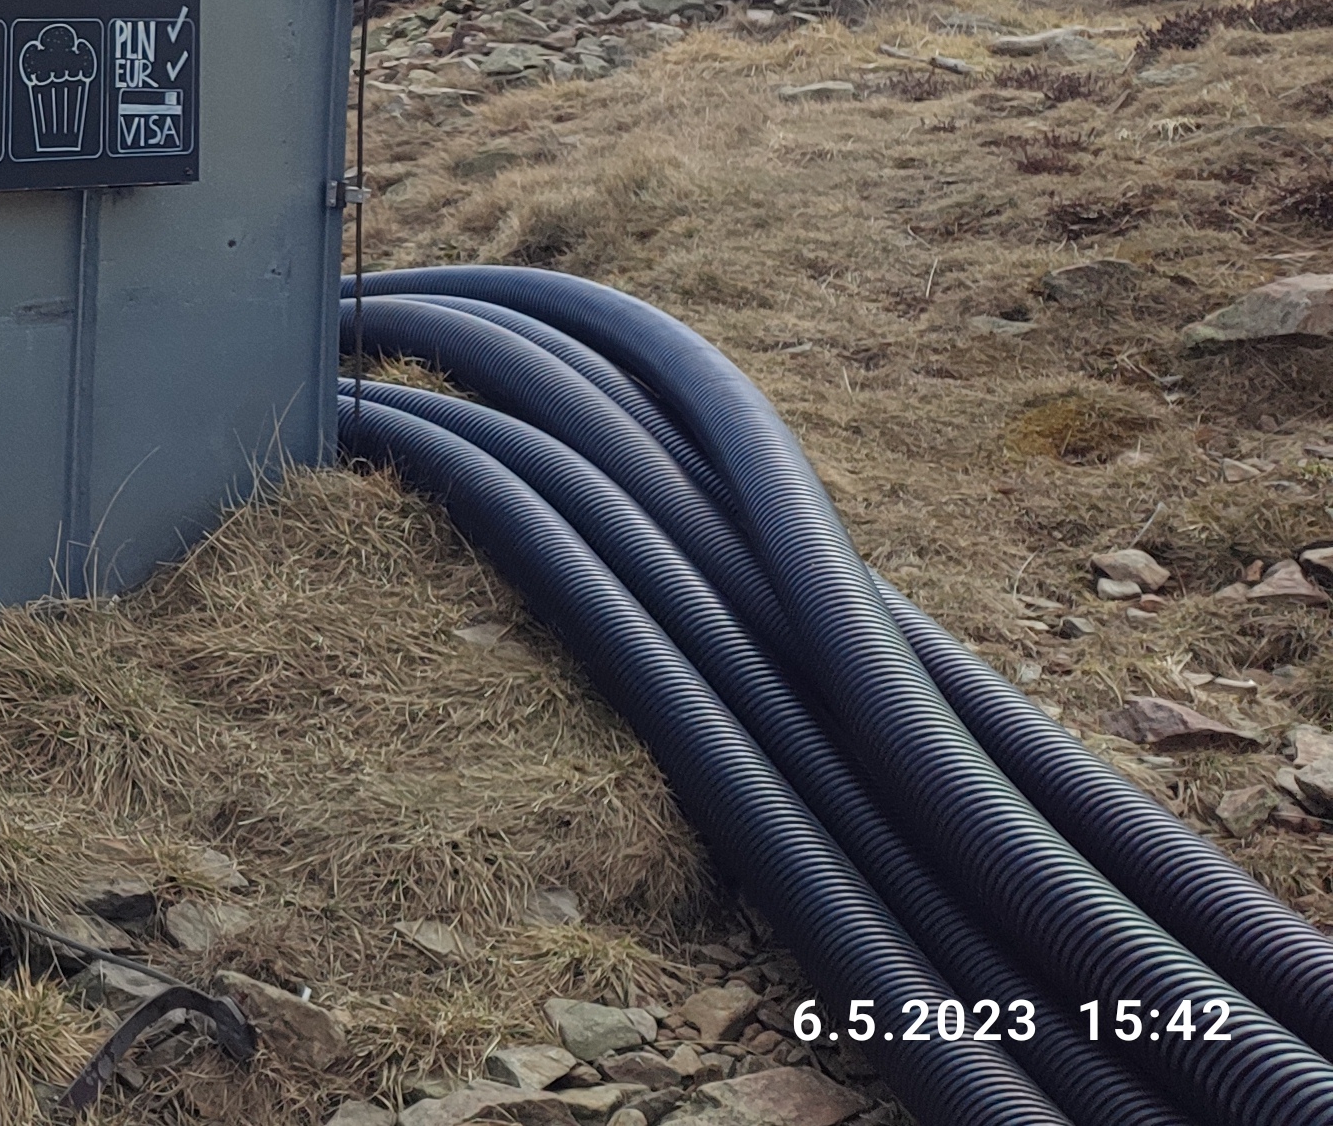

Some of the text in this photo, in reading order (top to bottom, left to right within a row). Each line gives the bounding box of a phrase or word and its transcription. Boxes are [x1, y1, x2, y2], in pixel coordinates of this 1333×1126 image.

[115, 19, 156, 62] PLN
[115, 59, 159, 88] EUR
[120, 115, 180, 147] VISA
